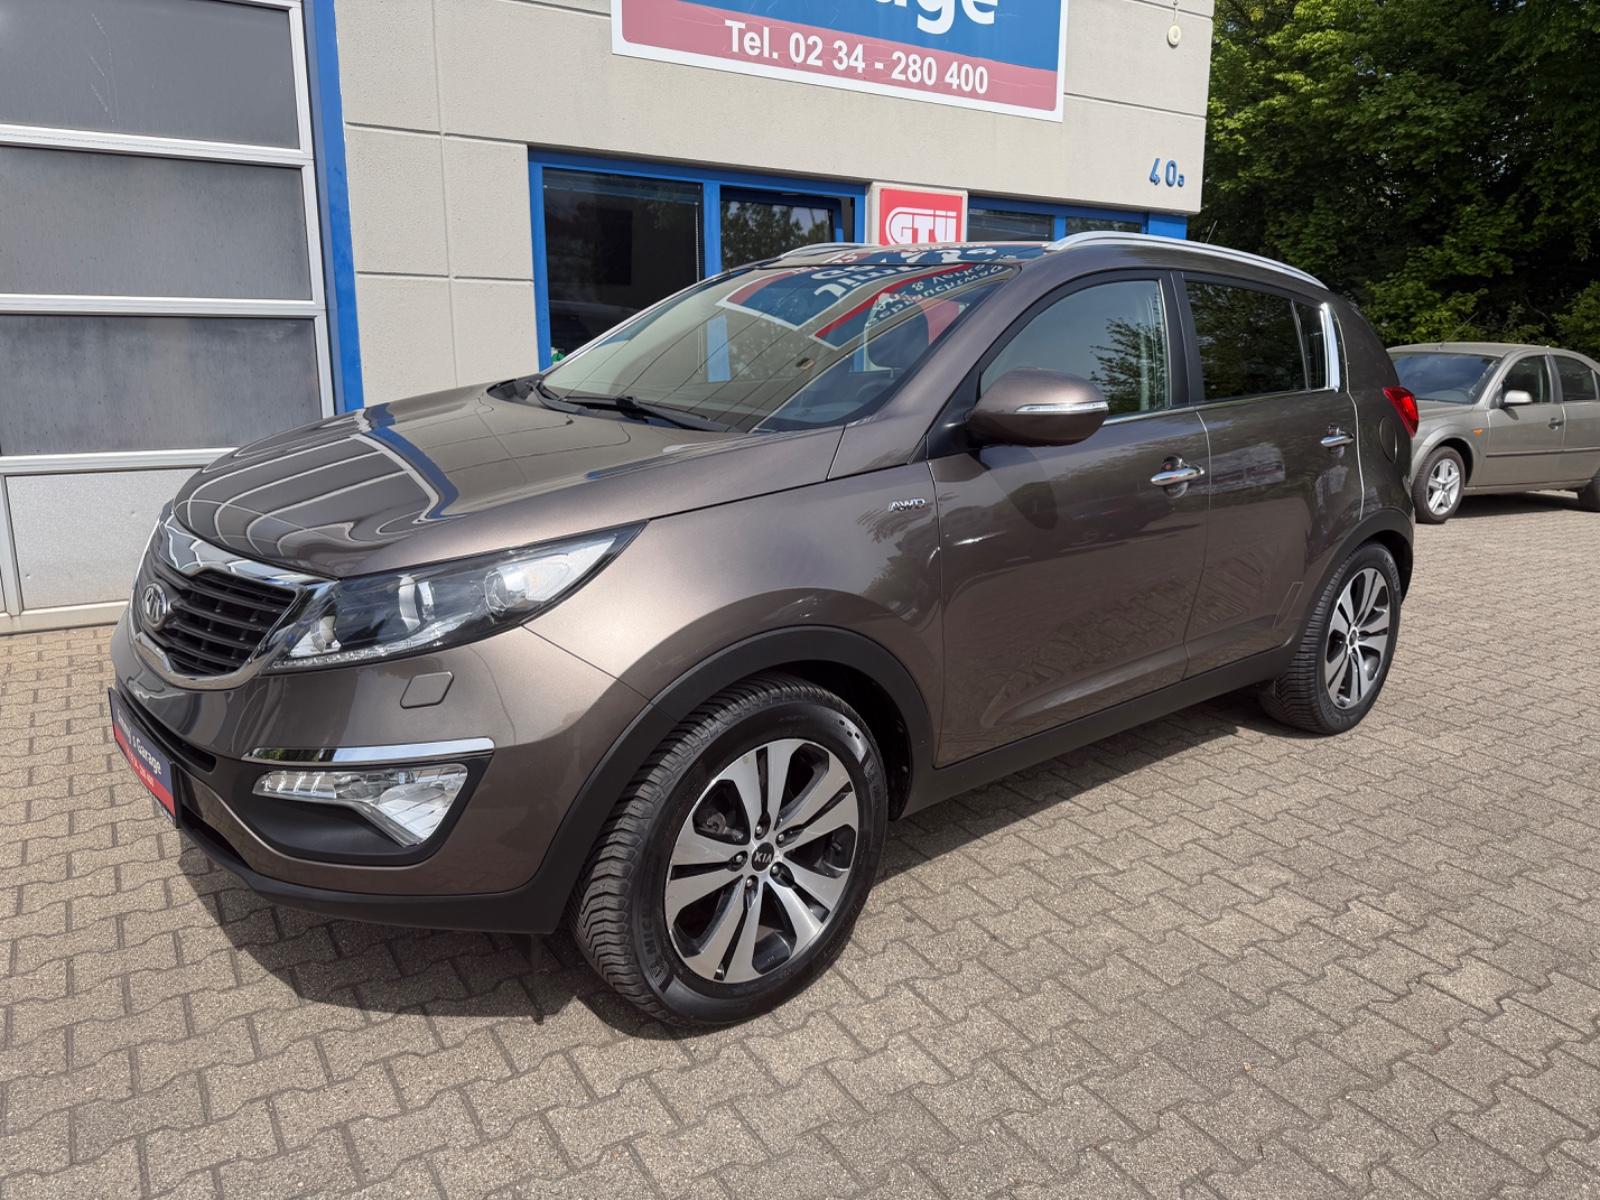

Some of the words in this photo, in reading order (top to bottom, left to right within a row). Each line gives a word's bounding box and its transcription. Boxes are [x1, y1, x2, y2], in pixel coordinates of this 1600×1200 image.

[724, 19, 779, 60] Tel.
[789, 32, 823, 67] 02
[832, 39, 866, 74] 34
[874, 61, 884, 70] -
[891, 50, 938, 86] 280
[944, 61, 989, 94] 400
[889, 498, 926, 512] AWD
[754, 850, 772, 863] KIA
